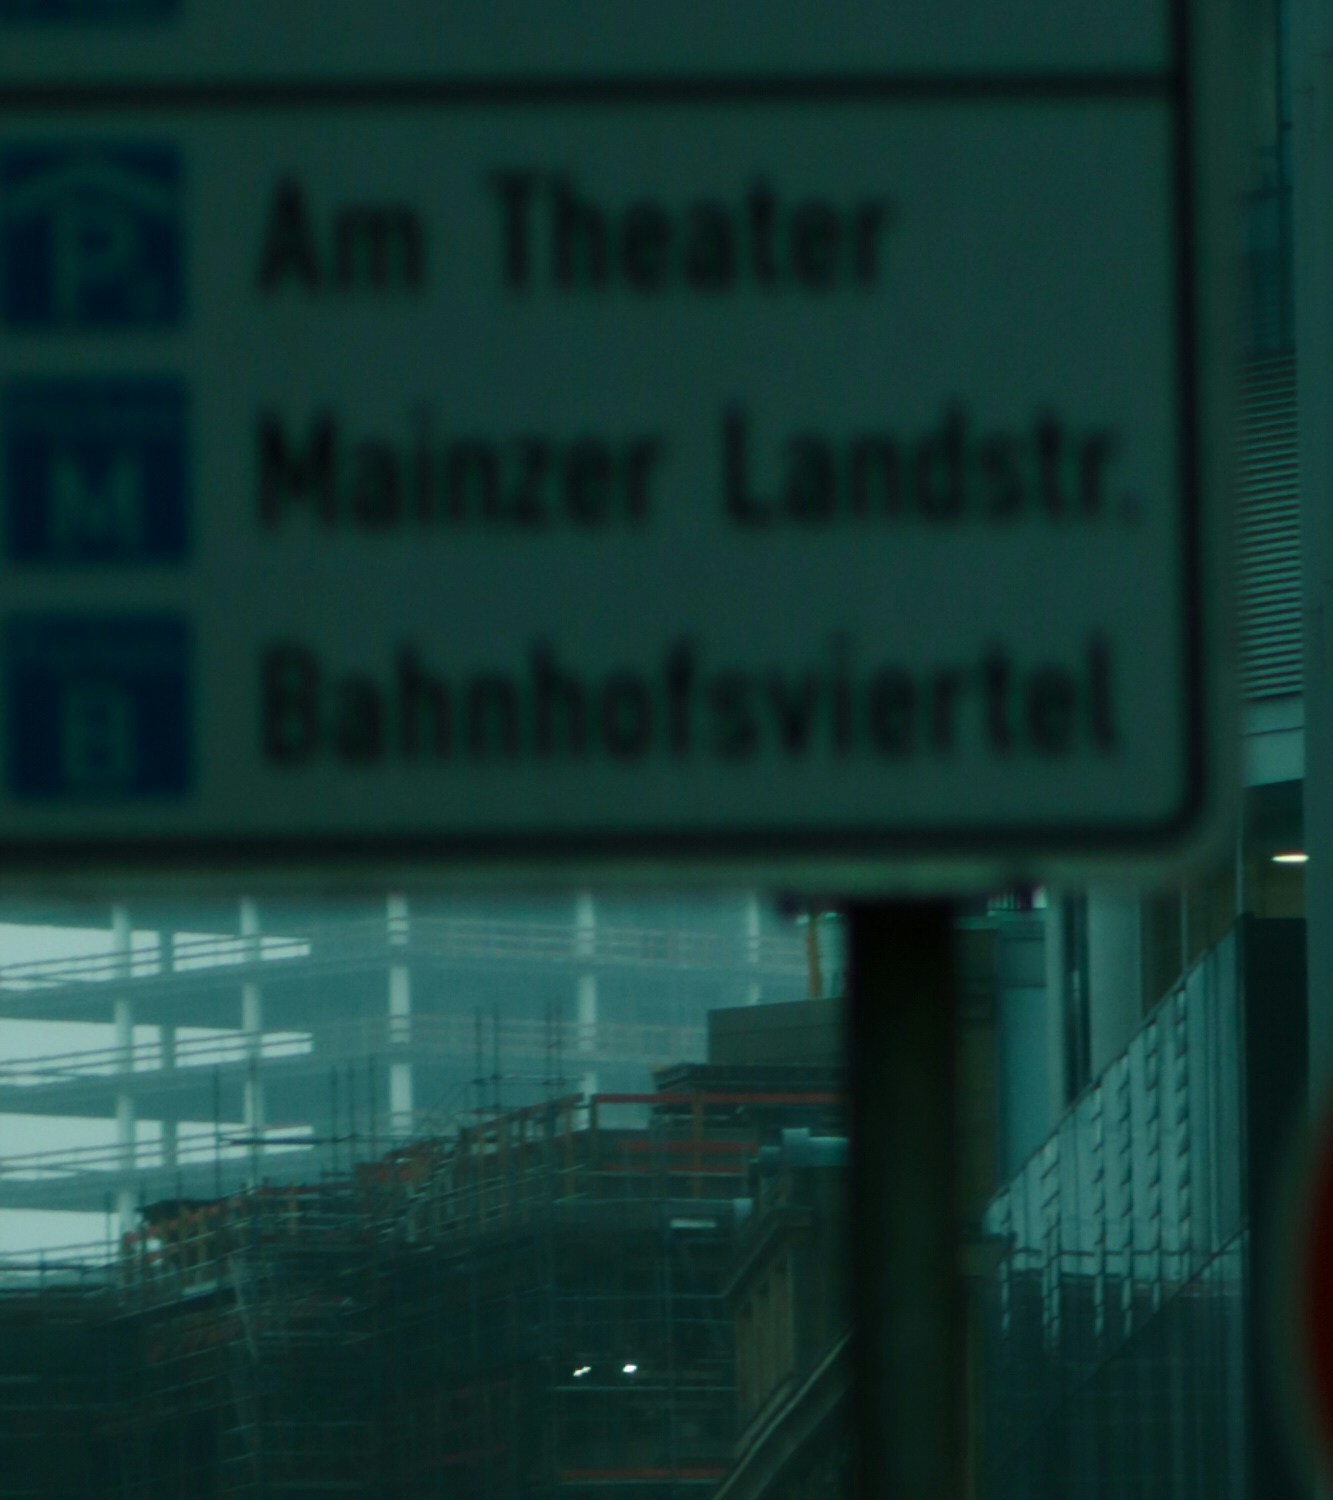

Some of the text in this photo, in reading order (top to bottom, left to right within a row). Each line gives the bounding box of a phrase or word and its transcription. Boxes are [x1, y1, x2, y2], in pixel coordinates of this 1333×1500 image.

[254, 178, 424, 294] Am
[488, 170, 893, 294] Theater
[254, 408, 666, 530] Mainzer
[722, 408, 1142, 530] Landstr.
[258, 636, 1120, 767] Bahnhofsviertel
